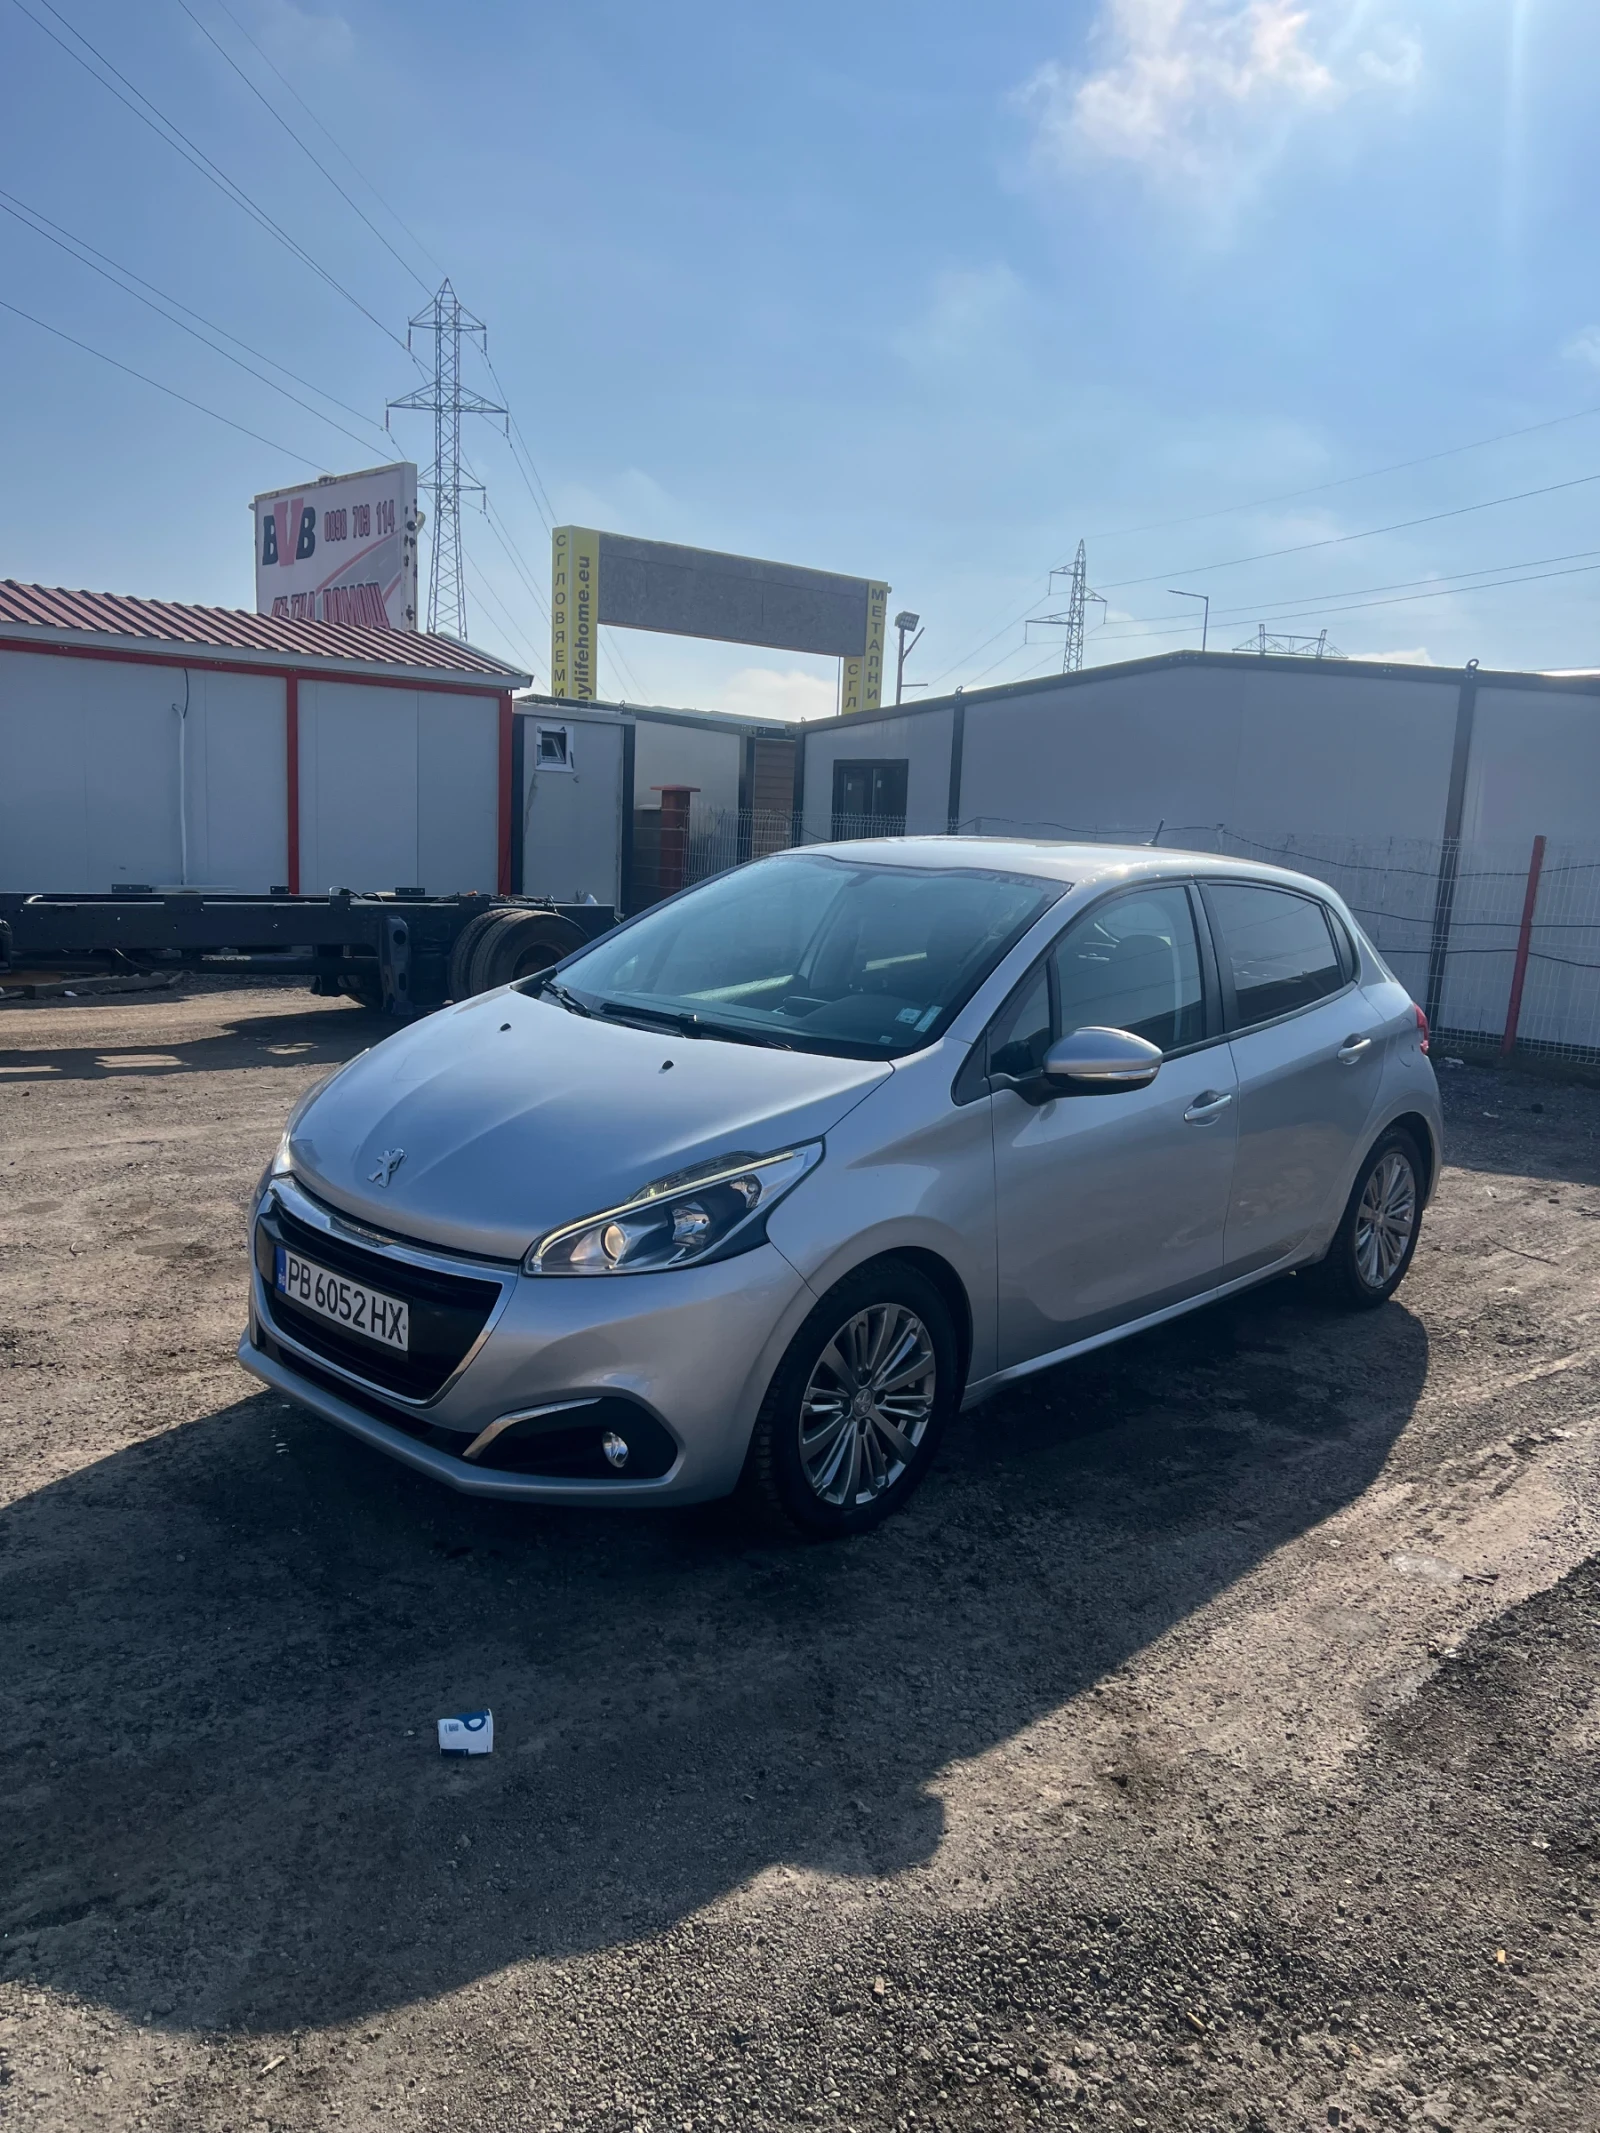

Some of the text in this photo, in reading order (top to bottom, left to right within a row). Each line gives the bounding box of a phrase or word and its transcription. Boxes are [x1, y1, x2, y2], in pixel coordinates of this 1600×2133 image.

[262, 497, 316, 567] BVB
[352, 503, 371, 538] 703
[376, 499, 395, 535] 114
[323, 581, 391, 631] ПОМОЩ
[554, 534, 566, 698] СГЛОВЯЕМИ
[867, 588, 884, 700] МЕТАЛНИ
[315, 1273, 366, 1330] 6052
[370, 1296, 404, 1344] HX
